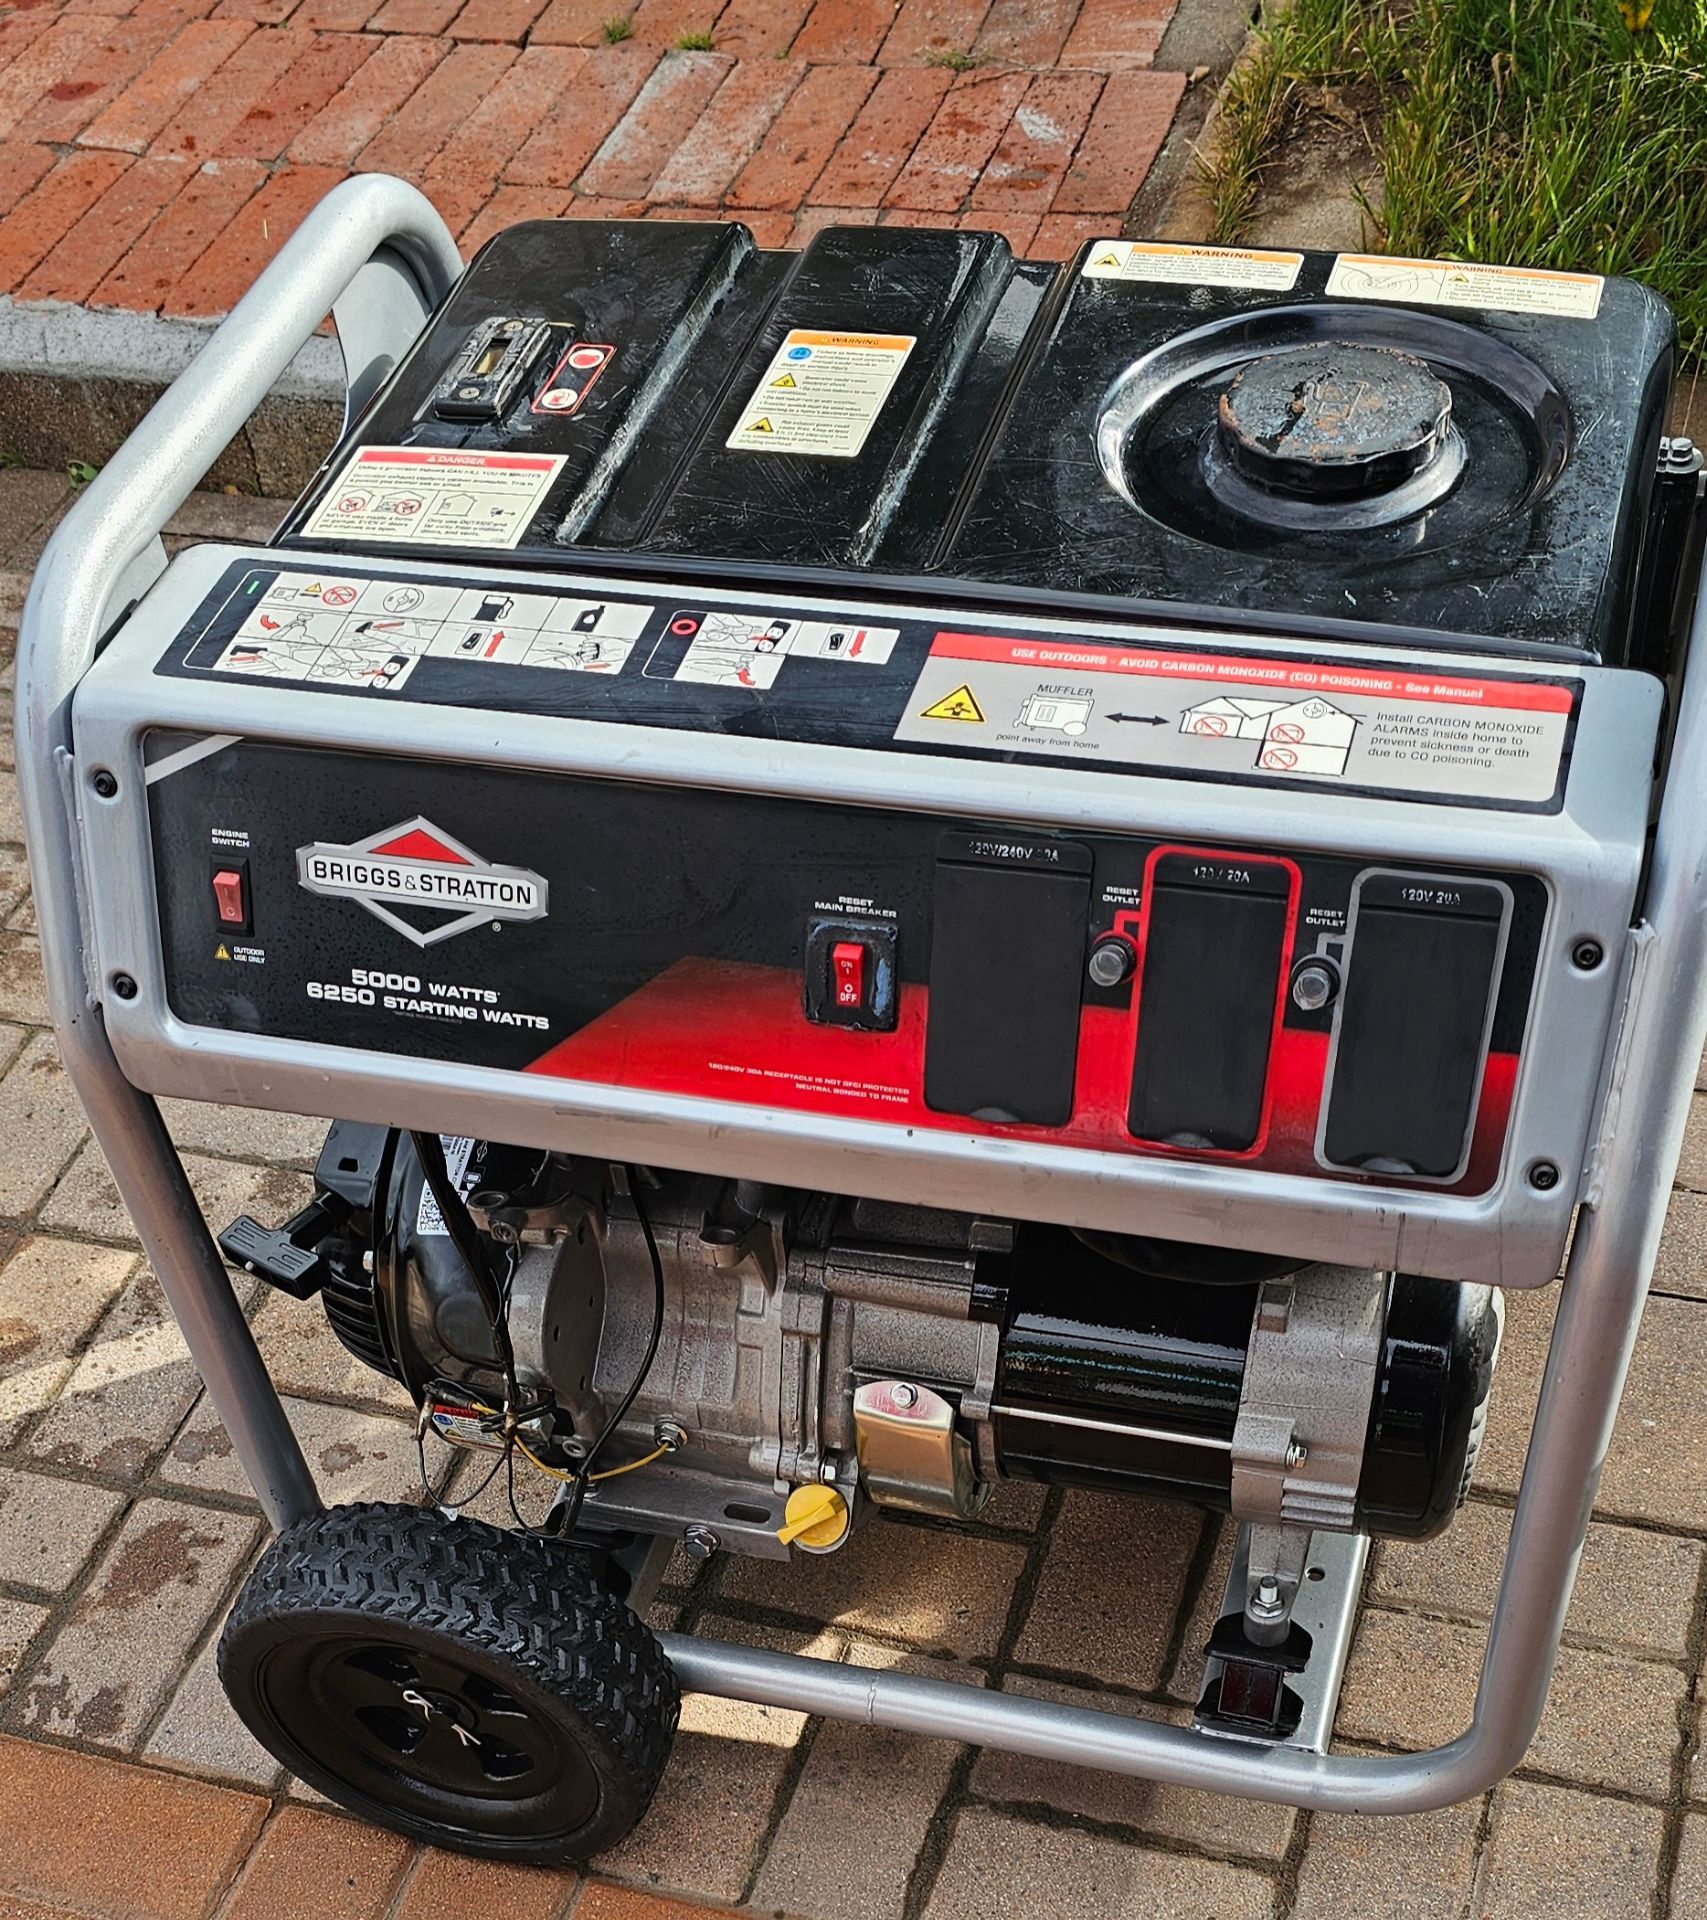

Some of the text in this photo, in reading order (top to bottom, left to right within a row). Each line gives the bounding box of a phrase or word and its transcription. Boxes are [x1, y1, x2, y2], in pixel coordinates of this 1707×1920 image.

[1191, 249, 1253, 259] WARNING
[1452, 264, 1502, 274] WARNING
[832, 337, 880, 346] WARNING
[438, 454, 486, 465] DANGER
[1012, 648, 1037, 659] USE
[1040, 650, 1107, 665] OUTDOORS
[1119, 657, 1159, 669] AVOID
[1162, 662, 1215, 673] CARBON
[1218, 665, 1286, 680] MONOXIDE
[1290, 672, 1317, 685] (CO)
[1321, 674, 1392, 690] POISONING
[1405, 682, 1430, 694] See
[1434, 685, 1483, 699] Manual
[1037, 684, 1094, 697] MUFFLER
[1376, 712, 1544, 736] Install CARBON MONOXIDE
[1373, 724, 1523, 746] ALARMS inside home to
[1022, 737, 1047, 745] away
[1049, 738, 1070, 746] from
[1073, 740, 1100, 750] home
[1370, 736, 1530, 758] prevent sickness or death
[1368, 748, 1495, 768] due to CO poisoning.
[211, 828, 249, 840] ENGINE
[211, 836, 250, 848] SWITCH
[314, 861, 531, 904] BRIGGS & STRATTON
[1106, 886, 1139, 896] RESET
[838, 896, 874, 907] RESET
[1102, 894, 1141, 905] OUTLET
[814, 901, 897, 918] MAIN BREAKER
[1309, 908, 1344, 918] RESET
[1305, 917, 1346, 928] OUTLET
[233, 946, 264, 956] OUTDOOR
[233, 954, 266, 964] USE ONLY
[841, 960, 853, 968] ON
[351, 968, 421, 993] 5000
[840, 992, 857, 1002] OFF
[306, 981, 376, 1006] 6250
[383, 995, 478, 1020] STARTING
[482, 1008, 550, 1030] WATTS
[708, 1062, 745, 1074] 120/240V
[747, 1068, 763, 1076] 30A
[764, 1070, 813, 1082] RECEPTACLE
[825, 1078, 842, 1086] NOT
[843, 1080, 862, 1089] GFCI
[863, 1083, 909, 1095] PROTECTED
[795, 1083, 909, 1104] NEUTRAL BONDED TO FRAME
[454, 1150, 466, 1176] STRATTON
